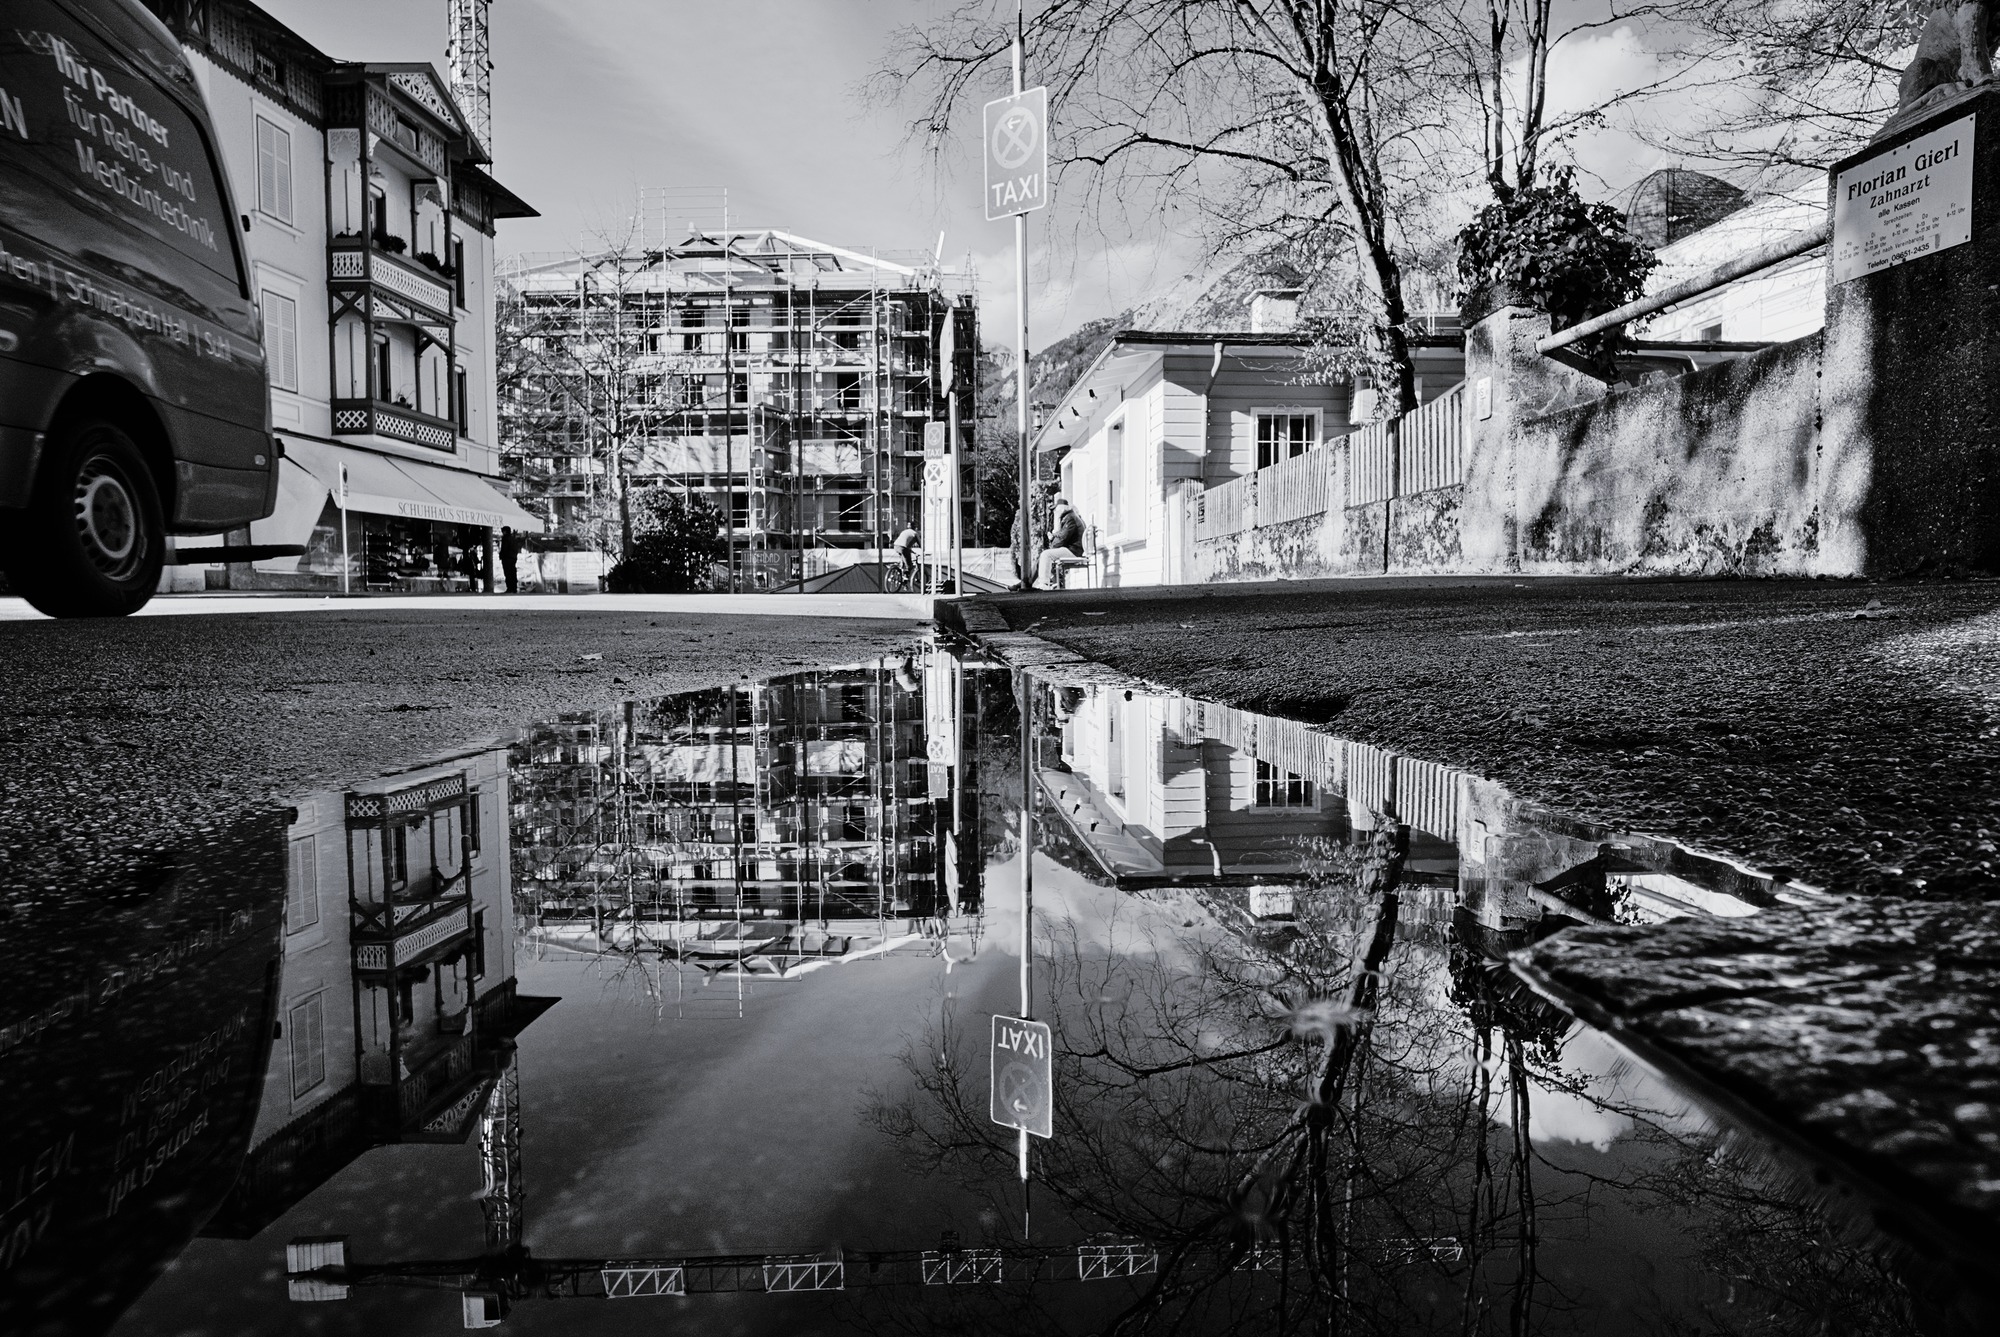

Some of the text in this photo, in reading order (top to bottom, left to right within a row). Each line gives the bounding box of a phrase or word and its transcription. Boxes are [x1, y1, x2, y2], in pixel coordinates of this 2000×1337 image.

[50, 34, 169, 148] Ihr Partner
[0, 87, 28, 140] N
[63, 85, 196, 203] für Reha- und
[1847, 139, 1959, 201] Florian Gierl
[74, 138, 218, 252] Medizintechnik
[991, 173, 1039, 207] TAXI
[1869, 174, 1931, 209] Zahnarzt
[1878, 197, 1921, 219] alle Kassen
[1867, 258, 1889, 270] Telefon
[926, 448, 942, 458] TAXI
[398, 501, 504, 527] SCHUHHAUS STERZINGER
